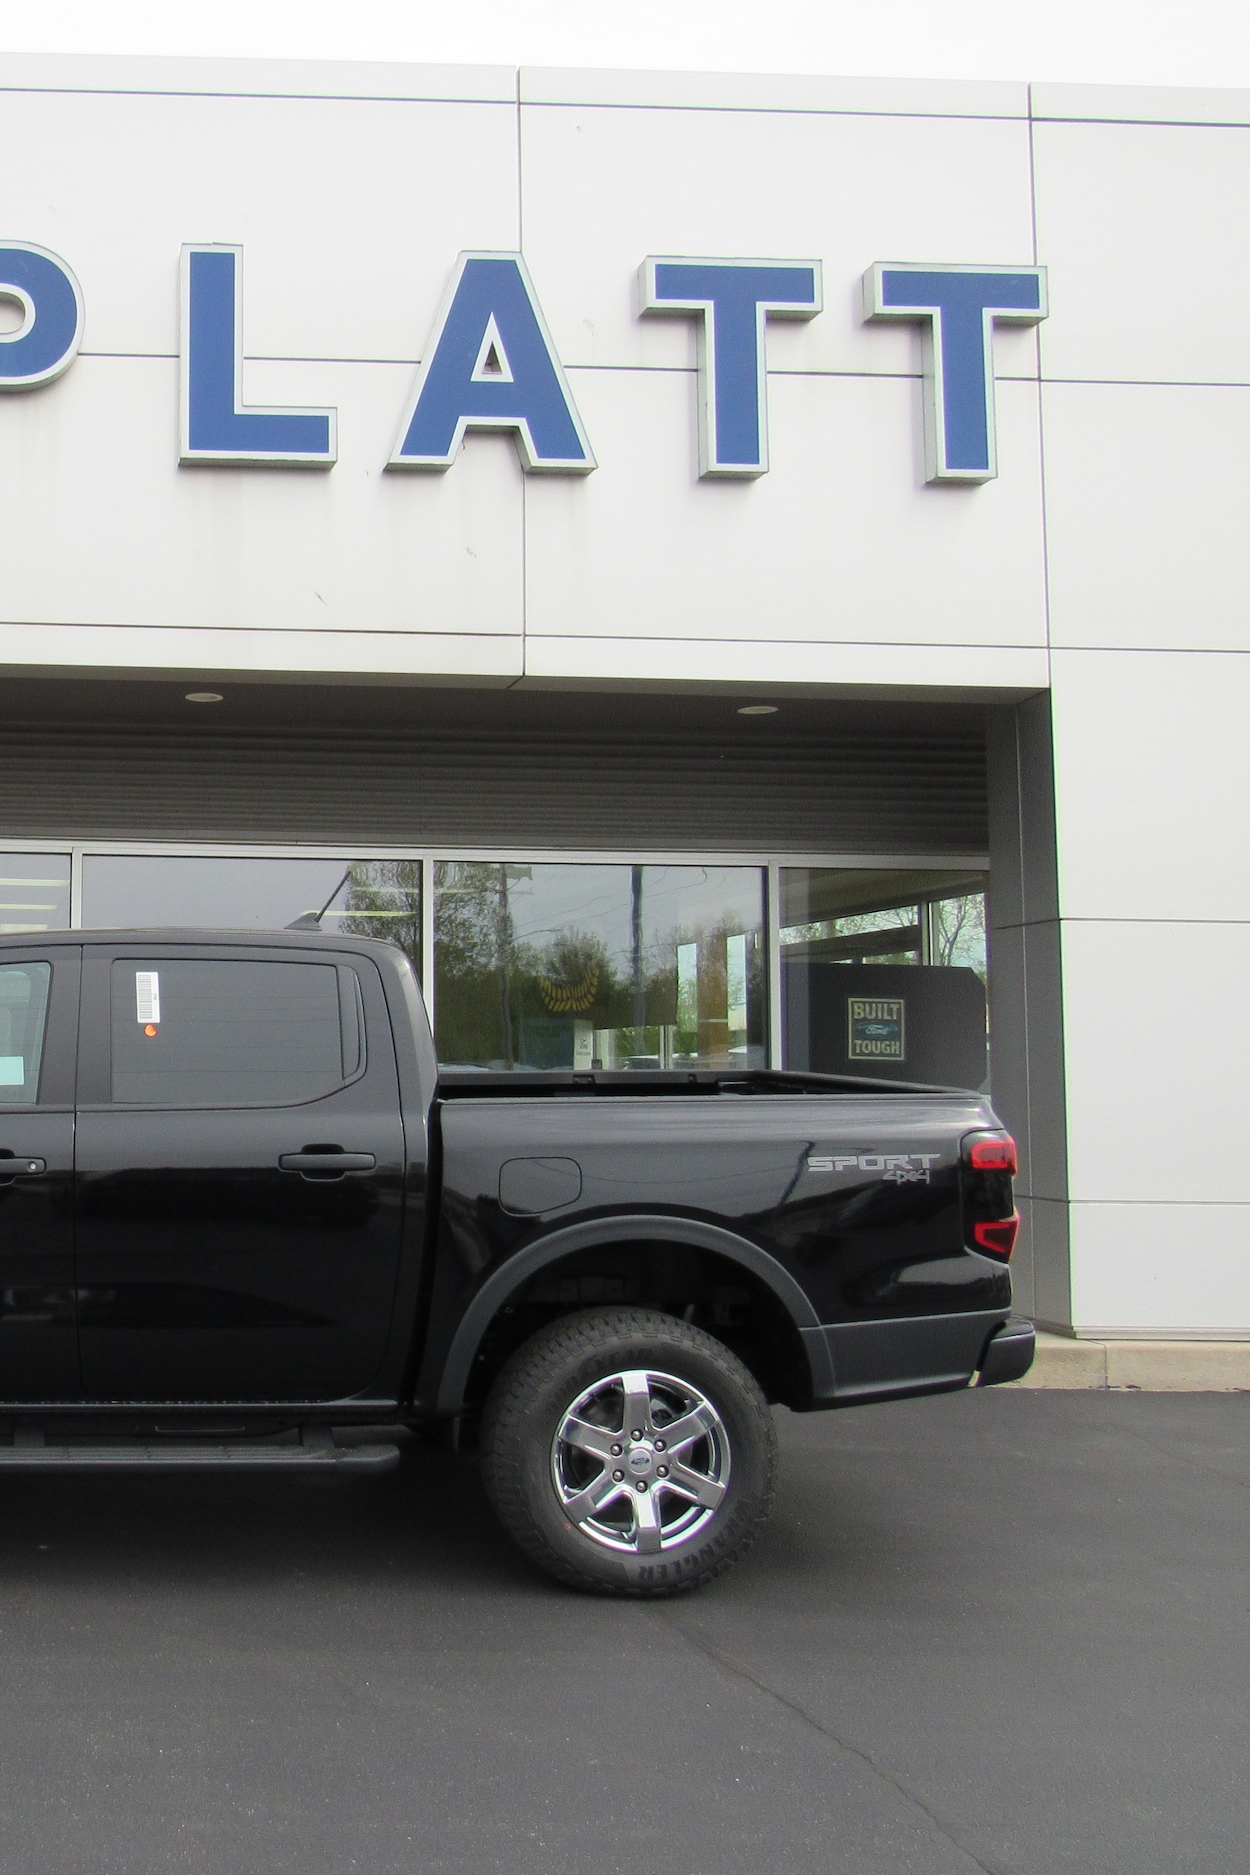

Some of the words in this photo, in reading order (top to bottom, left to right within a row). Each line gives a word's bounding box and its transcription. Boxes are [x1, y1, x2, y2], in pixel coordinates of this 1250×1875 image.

[853, 1003, 899, 1020] BUILT
[854, 1040, 900, 1054] TOUGH
[807, 1153, 940, 1172] SPORT
